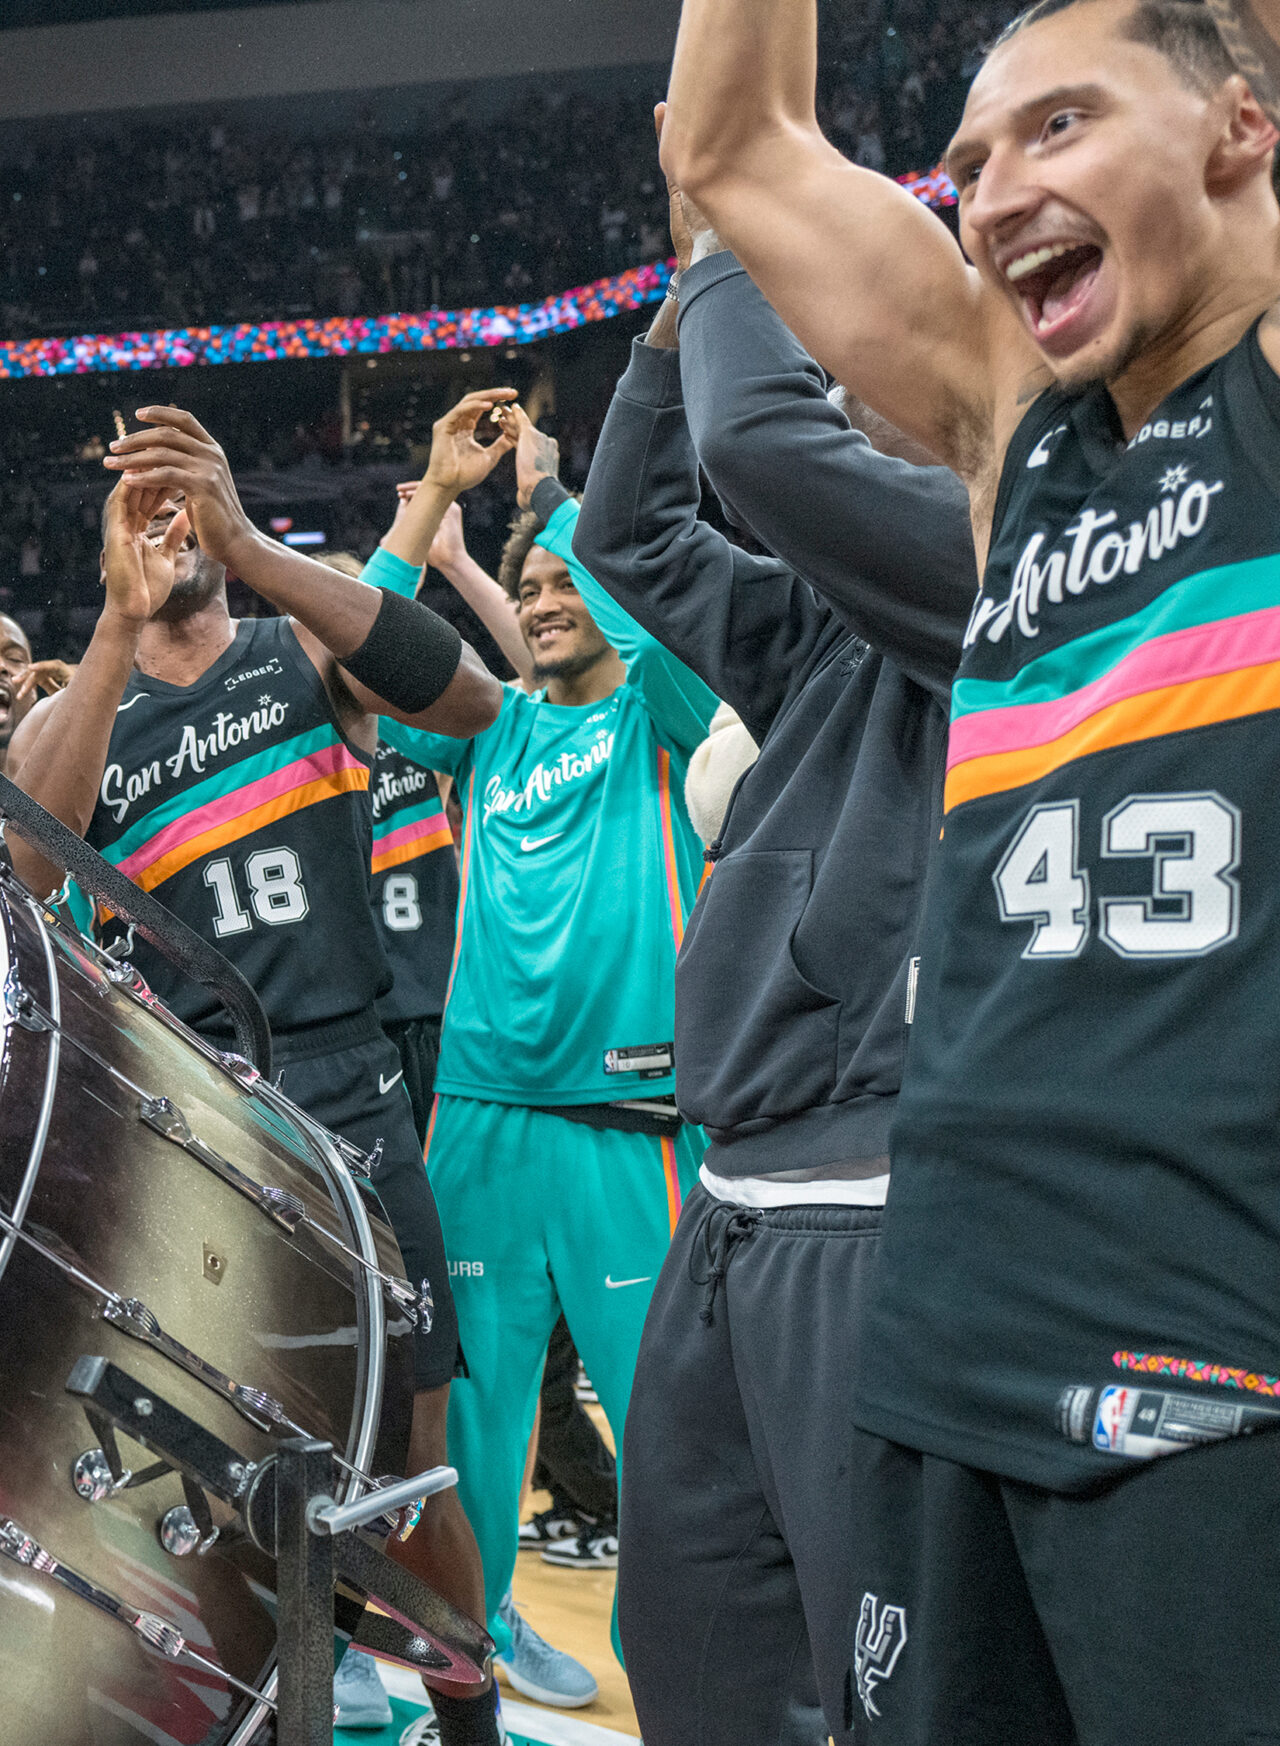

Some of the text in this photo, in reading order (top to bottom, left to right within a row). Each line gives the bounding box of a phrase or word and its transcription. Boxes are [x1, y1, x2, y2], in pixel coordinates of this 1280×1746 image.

[1126, 414, 1202, 451] DGER
[986, 463, 1225, 644] Antonio
[231, 664, 275, 686] LEDGER
[100, 694, 289, 825] San Antonio
[524, 729, 616, 811] Antoni
[202, 845, 311, 939] 18
[382, 872, 424, 932] 8
[991, 789, 1243, 960] 43
[447, 1260, 485, 1277] URS
